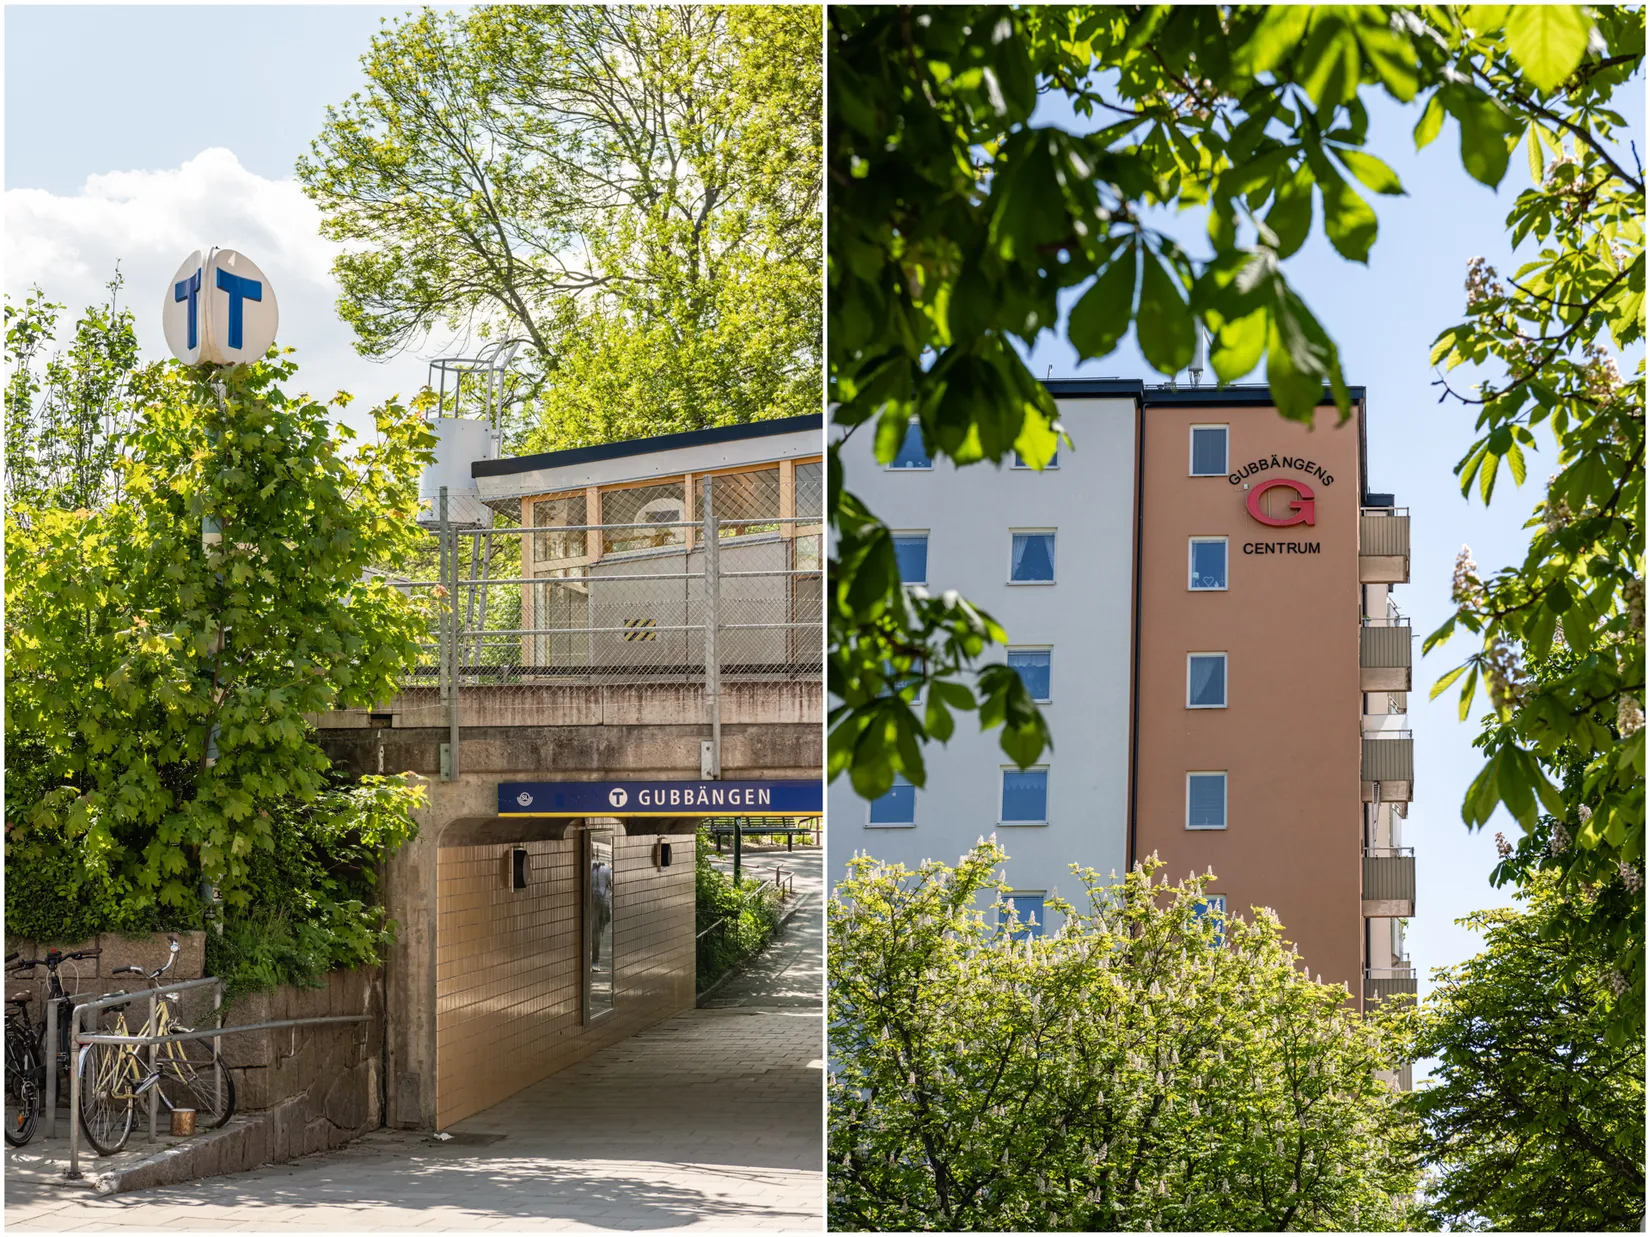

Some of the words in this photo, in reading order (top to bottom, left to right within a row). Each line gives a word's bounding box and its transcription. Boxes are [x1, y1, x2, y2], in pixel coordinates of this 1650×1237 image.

[175, 266, 201, 350] T
[216, 266, 262, 350] T
[1228, 454, 1334, 487] GUBBÄNGENS
[1246, 478, 1315, 528] G
[1243, 542, 1320, 554] CENTRUM
[638, 786, 771, 806] GUBBÄNGEN
